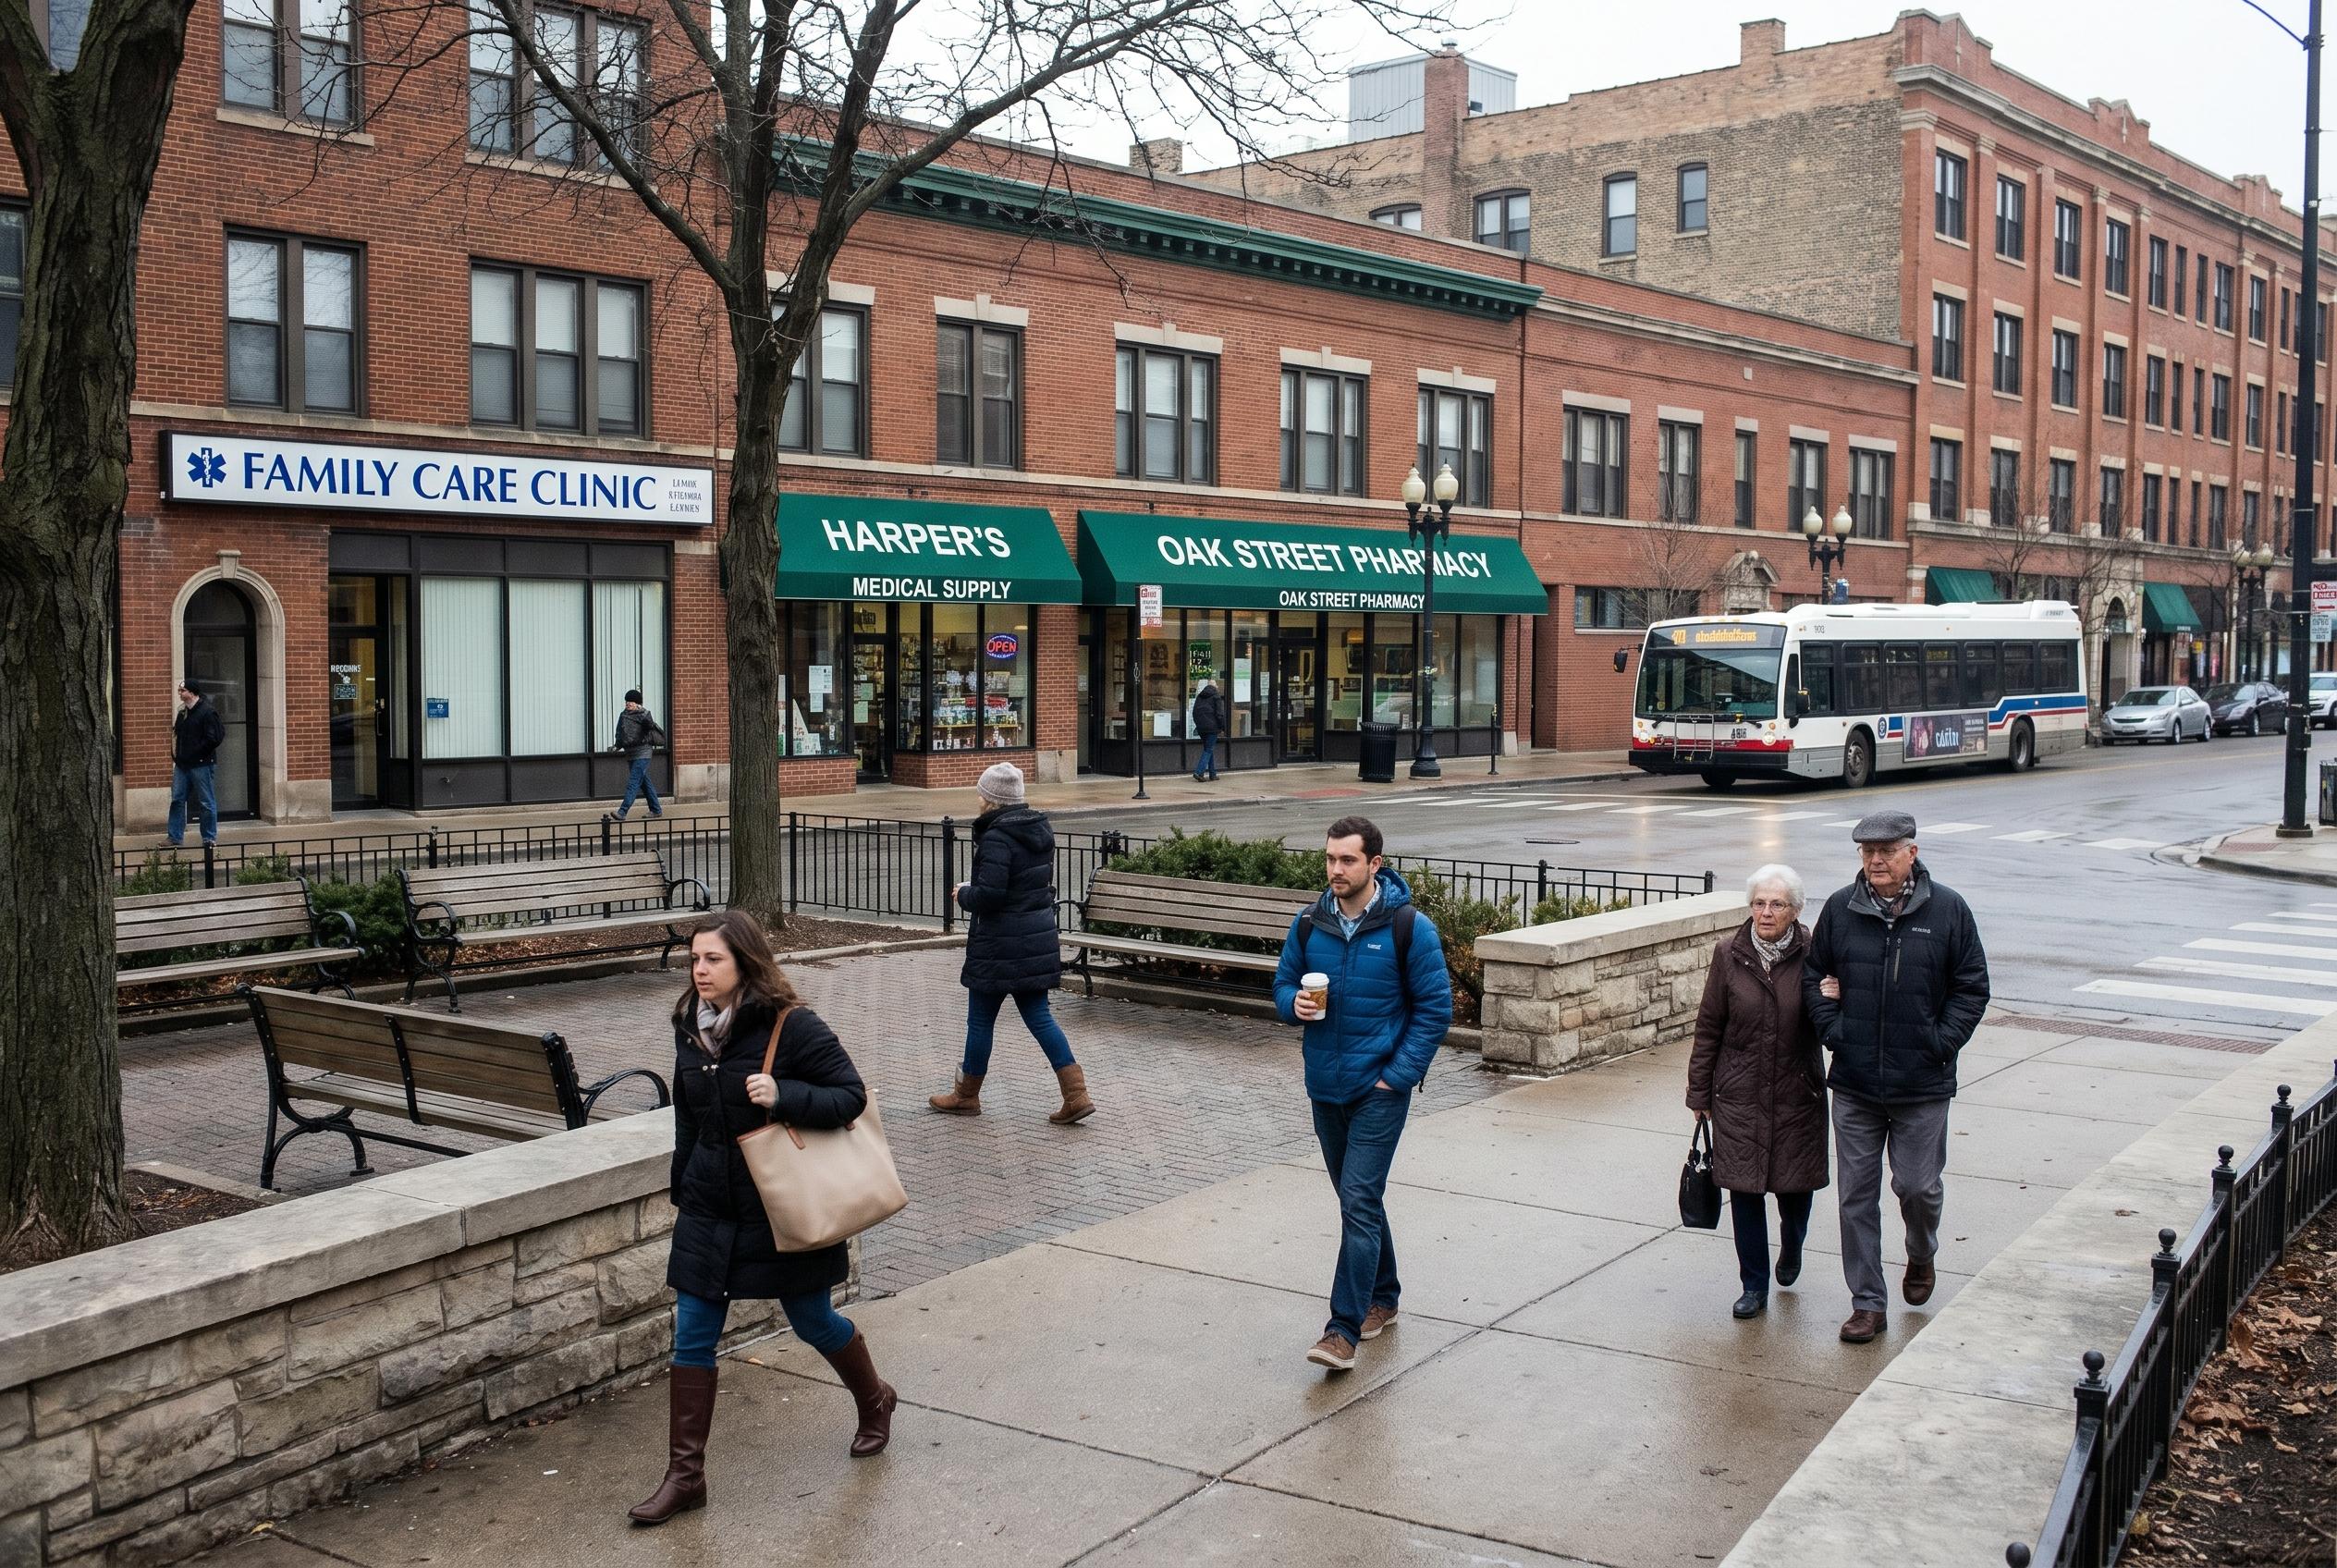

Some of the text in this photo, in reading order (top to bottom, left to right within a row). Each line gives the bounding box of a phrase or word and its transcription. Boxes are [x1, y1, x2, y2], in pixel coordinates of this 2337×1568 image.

[243, 452, 656, 510] FAMILY CARE CLINIC
[821, 519, 1011, 558] HARPER'S
[1157, 535, 1492, 578] OAK STREET PHARMACY
[852, 577, 1012, 599] MEDICAL SUPPLY
[1279, 590, 1425, 609] OAK STREET PHARMACY
[986, 640, 1017, 653] OPEN
